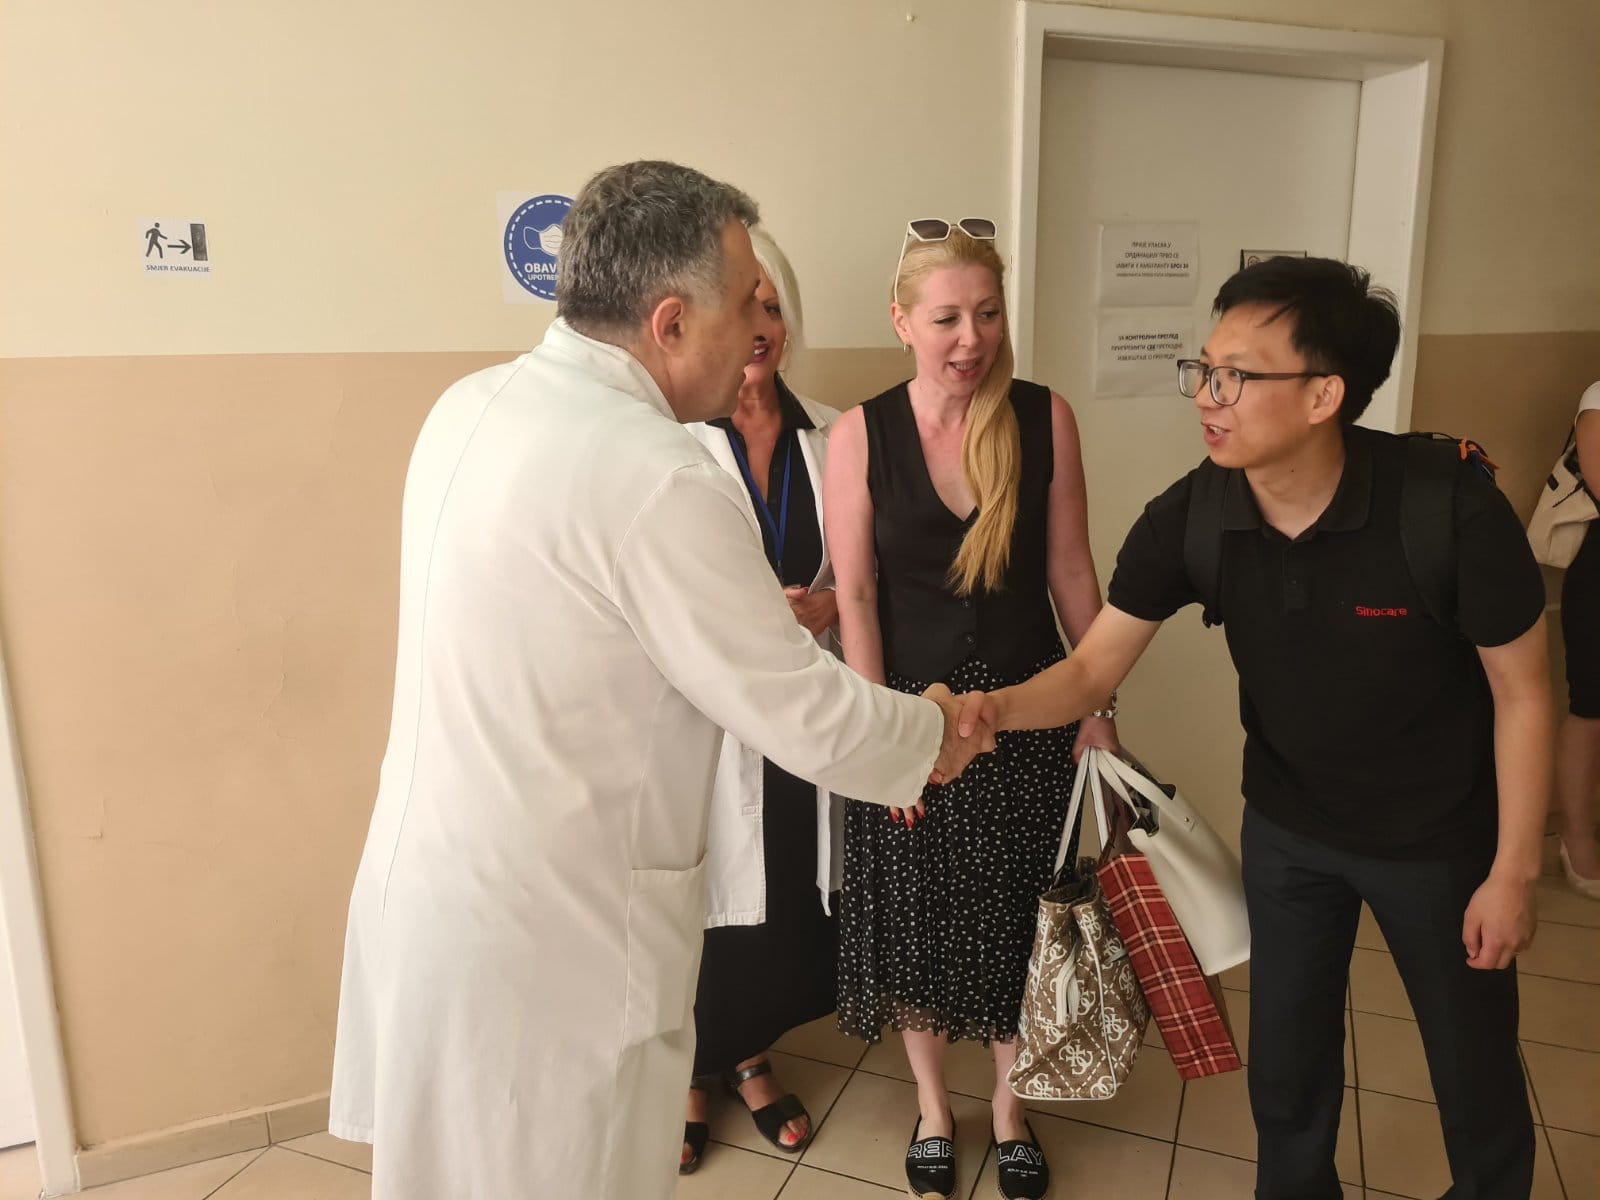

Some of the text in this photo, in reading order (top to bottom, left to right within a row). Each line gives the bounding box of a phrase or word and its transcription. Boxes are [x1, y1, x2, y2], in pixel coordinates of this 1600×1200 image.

[524, 262, 557, 273] OBAV
[1355, 606, 1407, 617] Sinocare
[998, 1144, 1042, 1166] LAY
